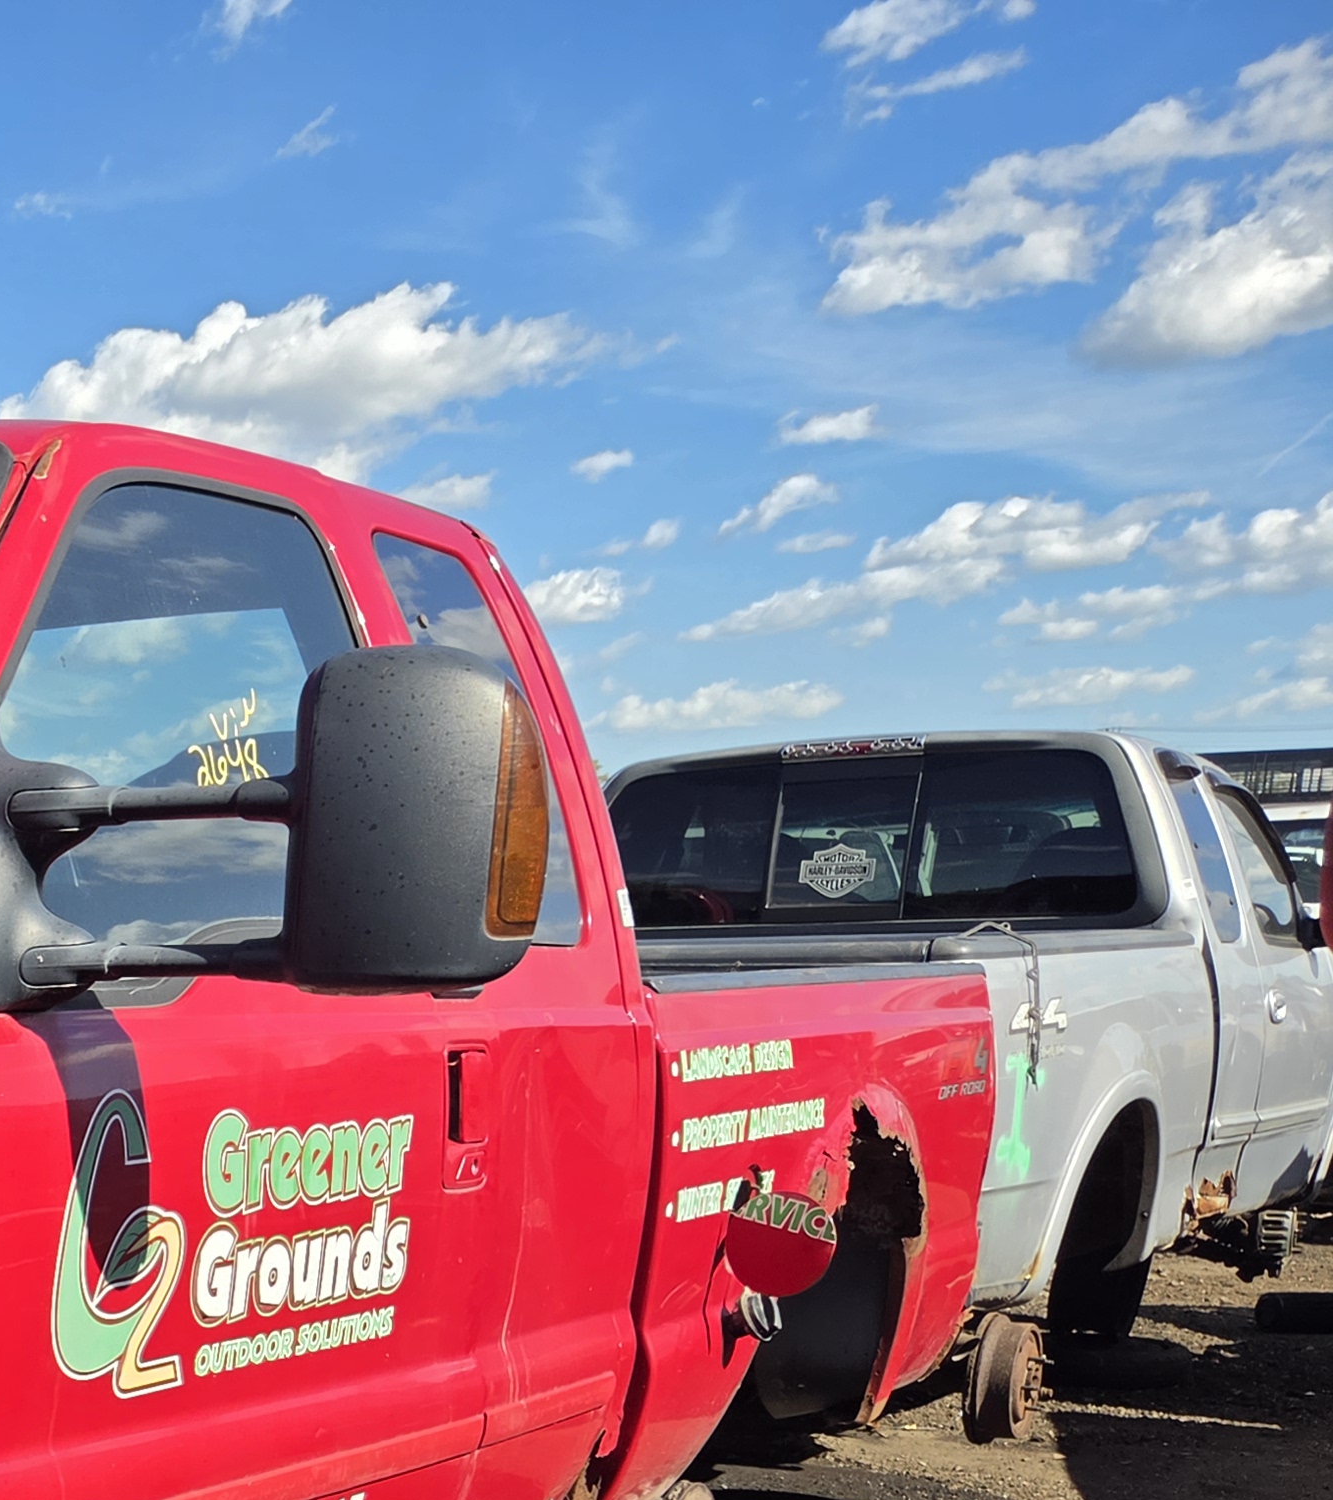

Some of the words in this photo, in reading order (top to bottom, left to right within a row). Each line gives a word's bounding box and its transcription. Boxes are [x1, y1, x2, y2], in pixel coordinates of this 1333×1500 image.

[680, 1043, 753, 1083] LANDSCAPE
[753, 1039, 795, 1073] DESIGN
[938, 1083, 960, 1101] OFF
[959, 1079, 987, 1097] ROAD
[681, 1109, 749, 1153] PROPERTY
[747, 1097, 826, 1142] MAINTENANCE
[202, 1108, 414, 1217] Greener
[675, 1181, 724, 1222] WINTER
[190, 1198, 410, 1328] Grounds
[194, 1327, 295, 1377] OUTDOOR
[295, 1305, 395, 1355] SOLUTIONS
